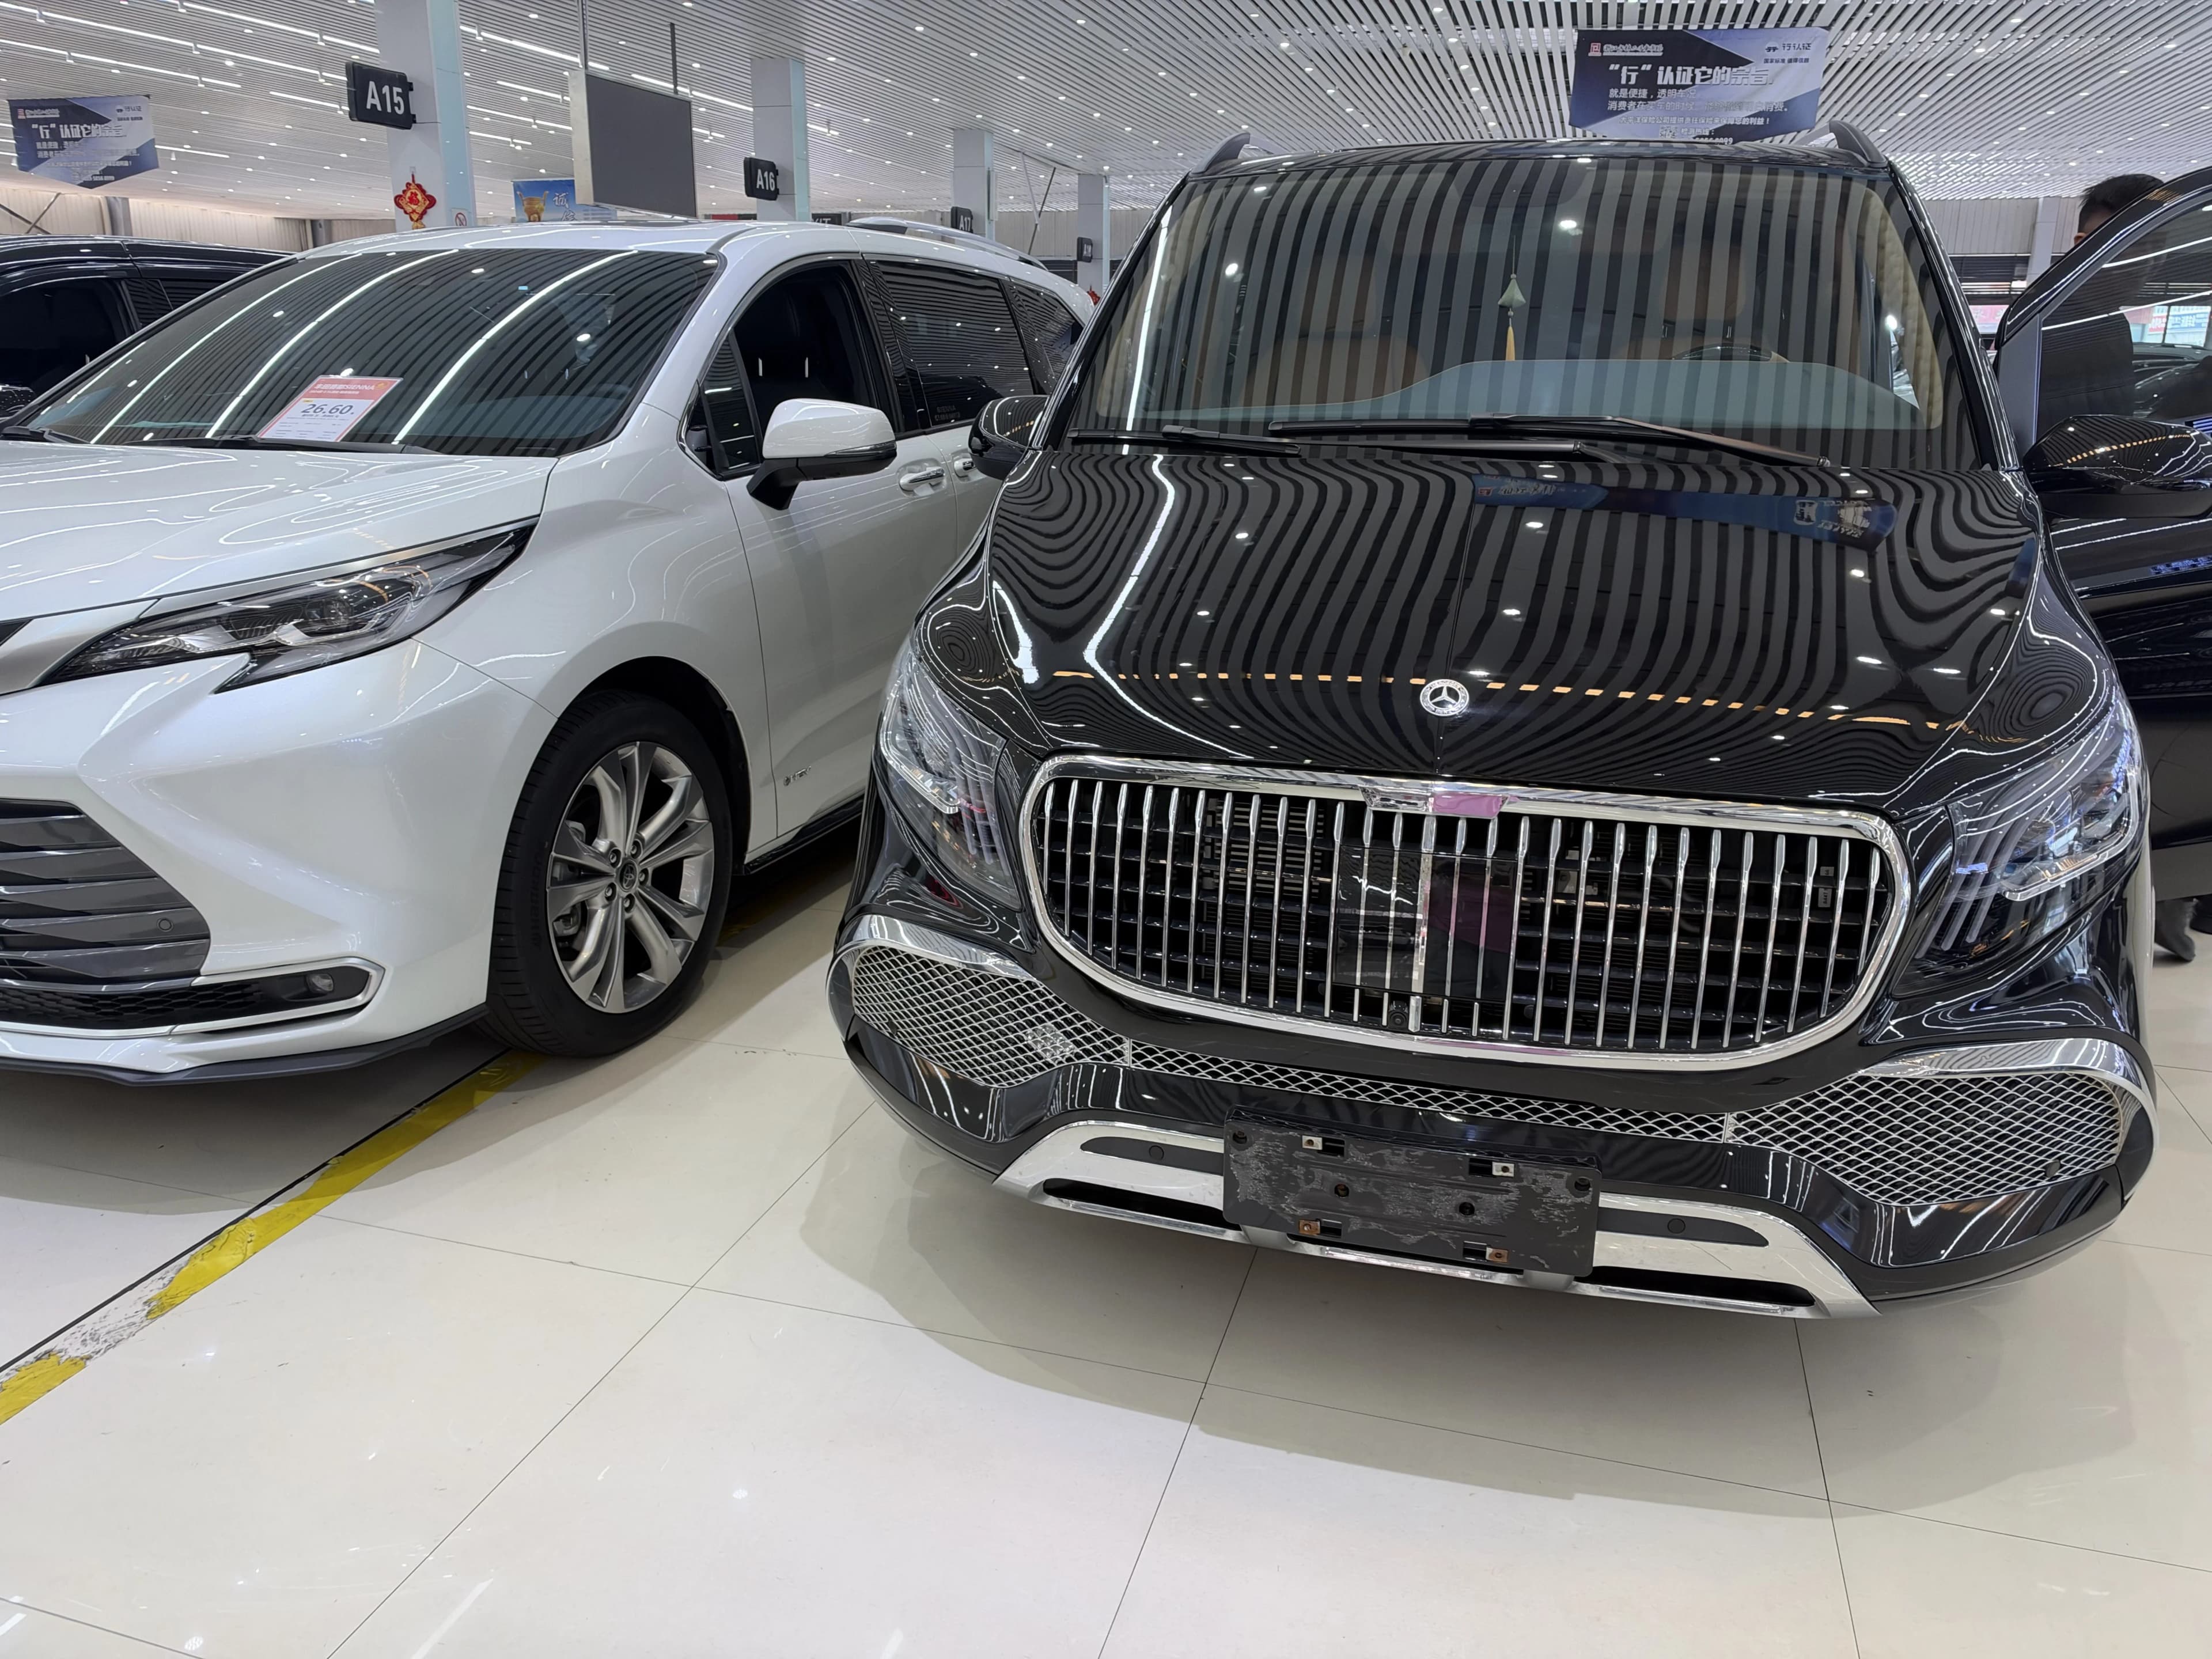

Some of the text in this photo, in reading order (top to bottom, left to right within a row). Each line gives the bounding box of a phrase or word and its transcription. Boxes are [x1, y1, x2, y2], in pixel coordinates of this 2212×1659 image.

[366, 81, 404, 115] A15
[756, 169, 775, 191] A16
[959, 215, 971, 232] A17
